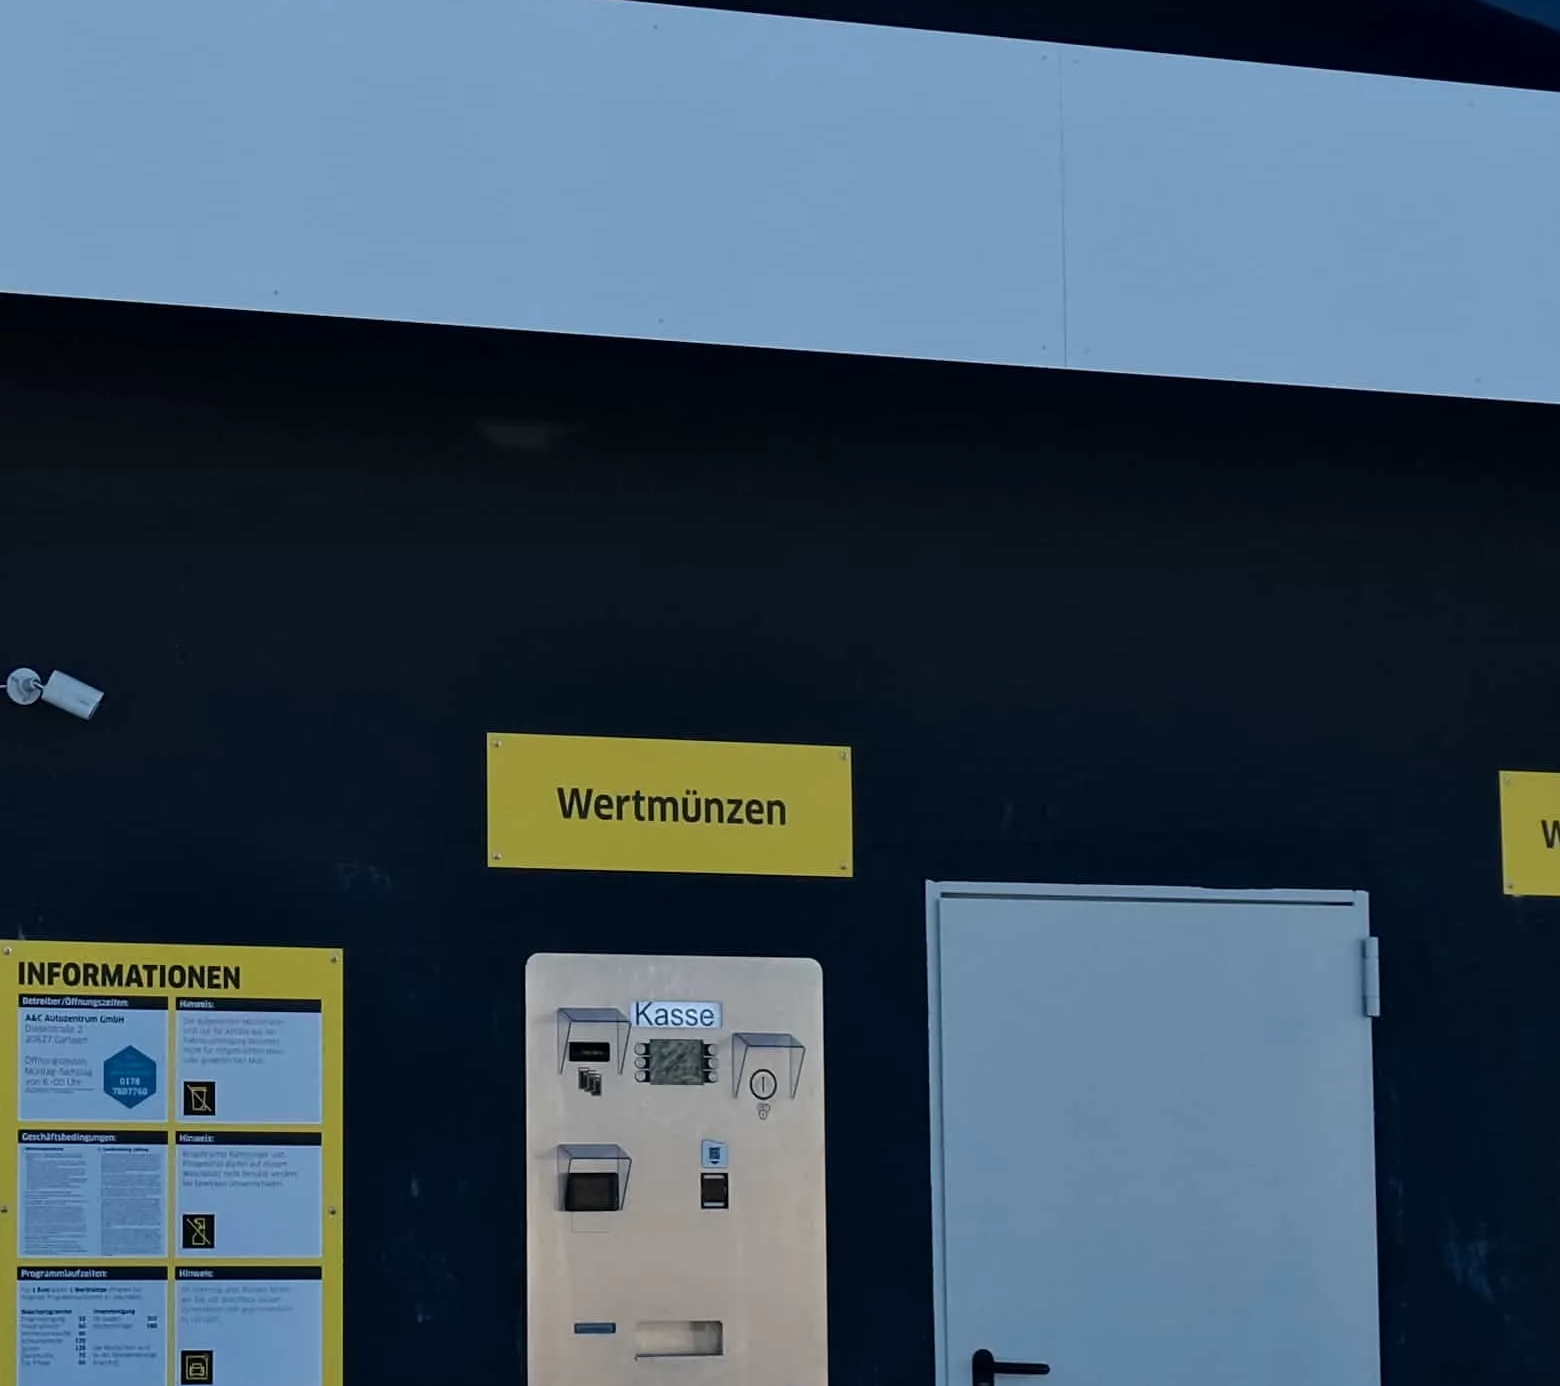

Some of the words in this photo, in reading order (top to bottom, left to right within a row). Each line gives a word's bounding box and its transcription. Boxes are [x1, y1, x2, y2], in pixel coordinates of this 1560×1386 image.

[557, 787, 786, 825] Wertmünzen
[18, 961, 241, 990] INFORMATIONEN
[636, 1001, 715, 1026] Kasse
